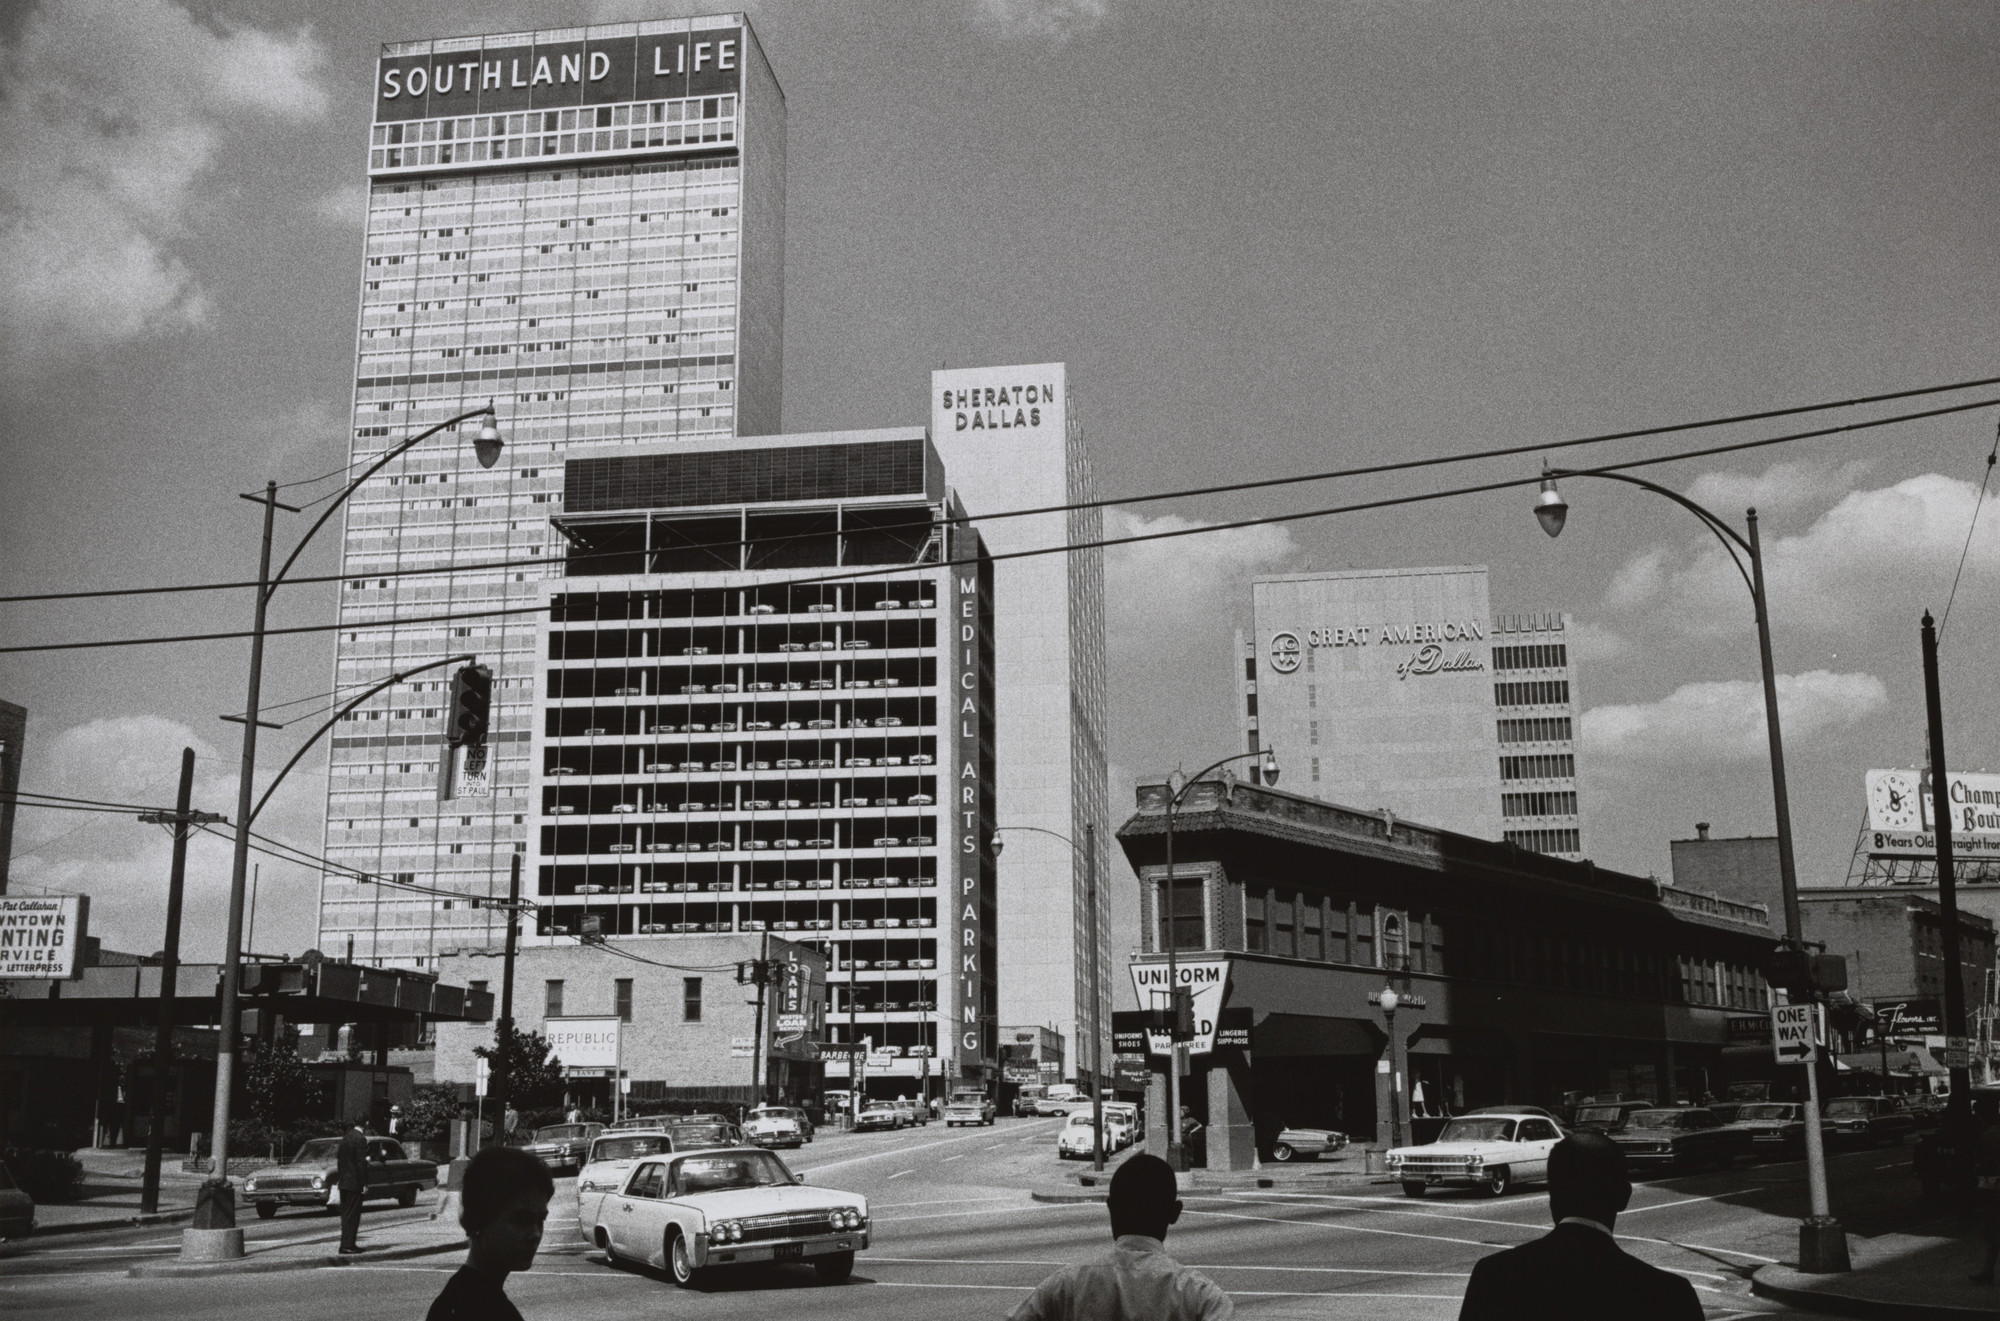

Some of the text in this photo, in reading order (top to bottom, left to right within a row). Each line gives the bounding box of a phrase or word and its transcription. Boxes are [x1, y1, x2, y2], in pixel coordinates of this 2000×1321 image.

[383, 39, 736, 99] SOUTHLAND LIFE
[943, 384, 1053, 409] SHERATON
[956, 408, 1041, 431] DALLAS
[1308, 622, 1484, 648] GREAT AMERICAN
[1397, 643, 1484, 681] of Dallas
[467, 749, 486, 760] NO
[464, 760, 487, 771] LEFT
[462, 771, 487, 781] TURN
[468, 786, 488, 795] PAUL
[960, 576, 978, 1050] MEDICAL ARTS PARKING
[1874, 833, 1885, 849] 8
[1884, 833, 1913, 848] Years
[1952, 837, 1981, 852] raight
[3, 900, 58, 911] Pat Callahan
[7, 963, 63, 973] LETTERPRESS
[787, 951, 799, 1011] LOANS
[1139, 967, 1220, 986] UNIORM
[1777, 1008, 1807, 1024] ONE
[776, 1019, 807, 1027] LOAN
[548, 1032, 615, 1044] REPUBLIC
[1114, 1032, 1143, 1040] UNIFORMS
[1219, 1029, 1248, 1037] LINGERIE
[1778, 1025, 1808, 1041] WAY
[1951, 1040, 1963, 1048] NO
[820, 1050, 865, 1060] BARBEUE
